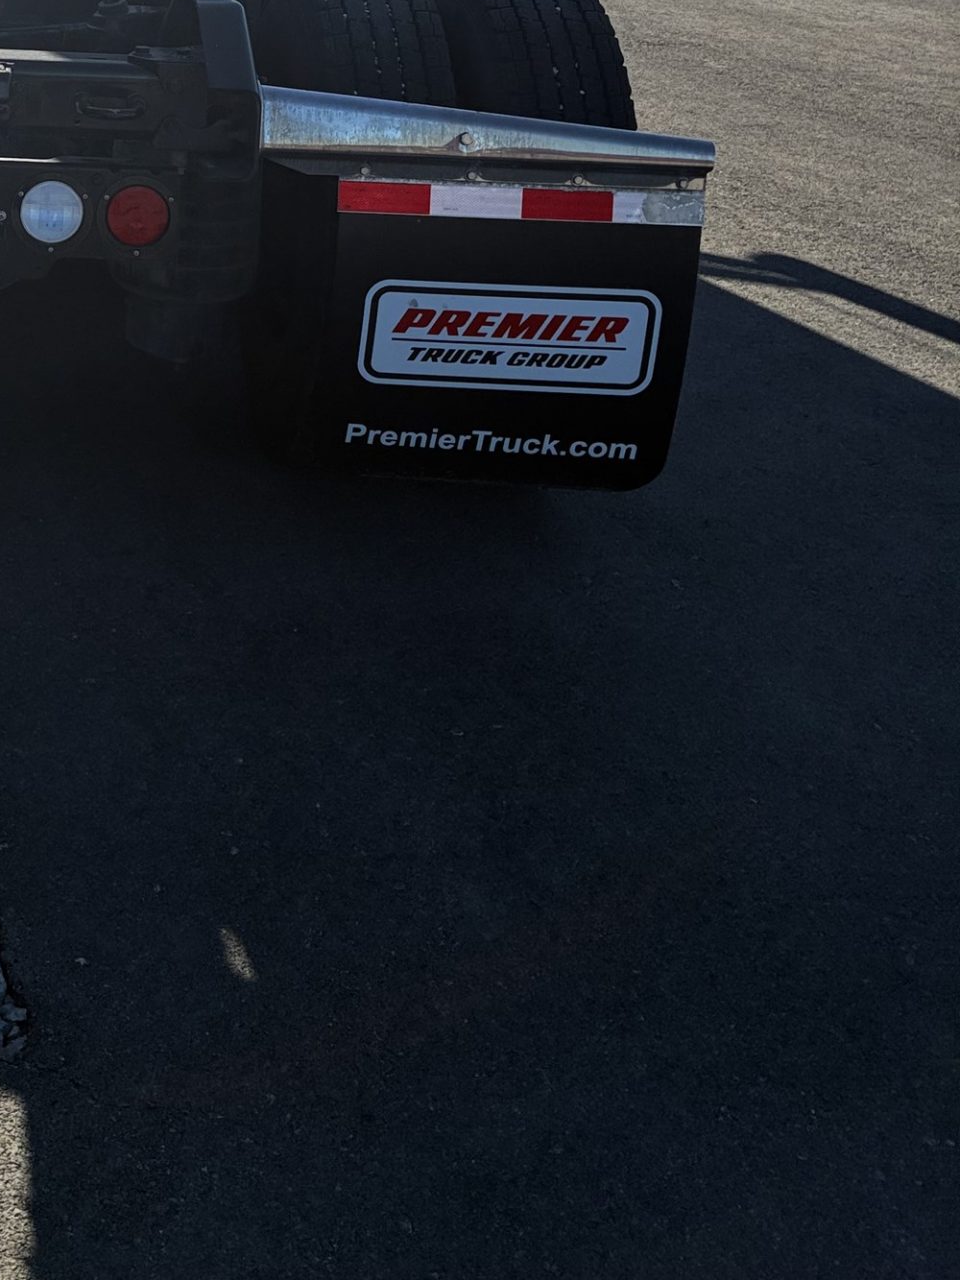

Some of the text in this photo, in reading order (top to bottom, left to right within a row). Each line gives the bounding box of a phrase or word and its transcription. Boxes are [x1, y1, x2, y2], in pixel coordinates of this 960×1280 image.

[392, 307, 630, 344] PREMIER
[406, 346, 608, 370] TRUCK GROUP
[344, 423, 638, 461] PremierTruck.com
